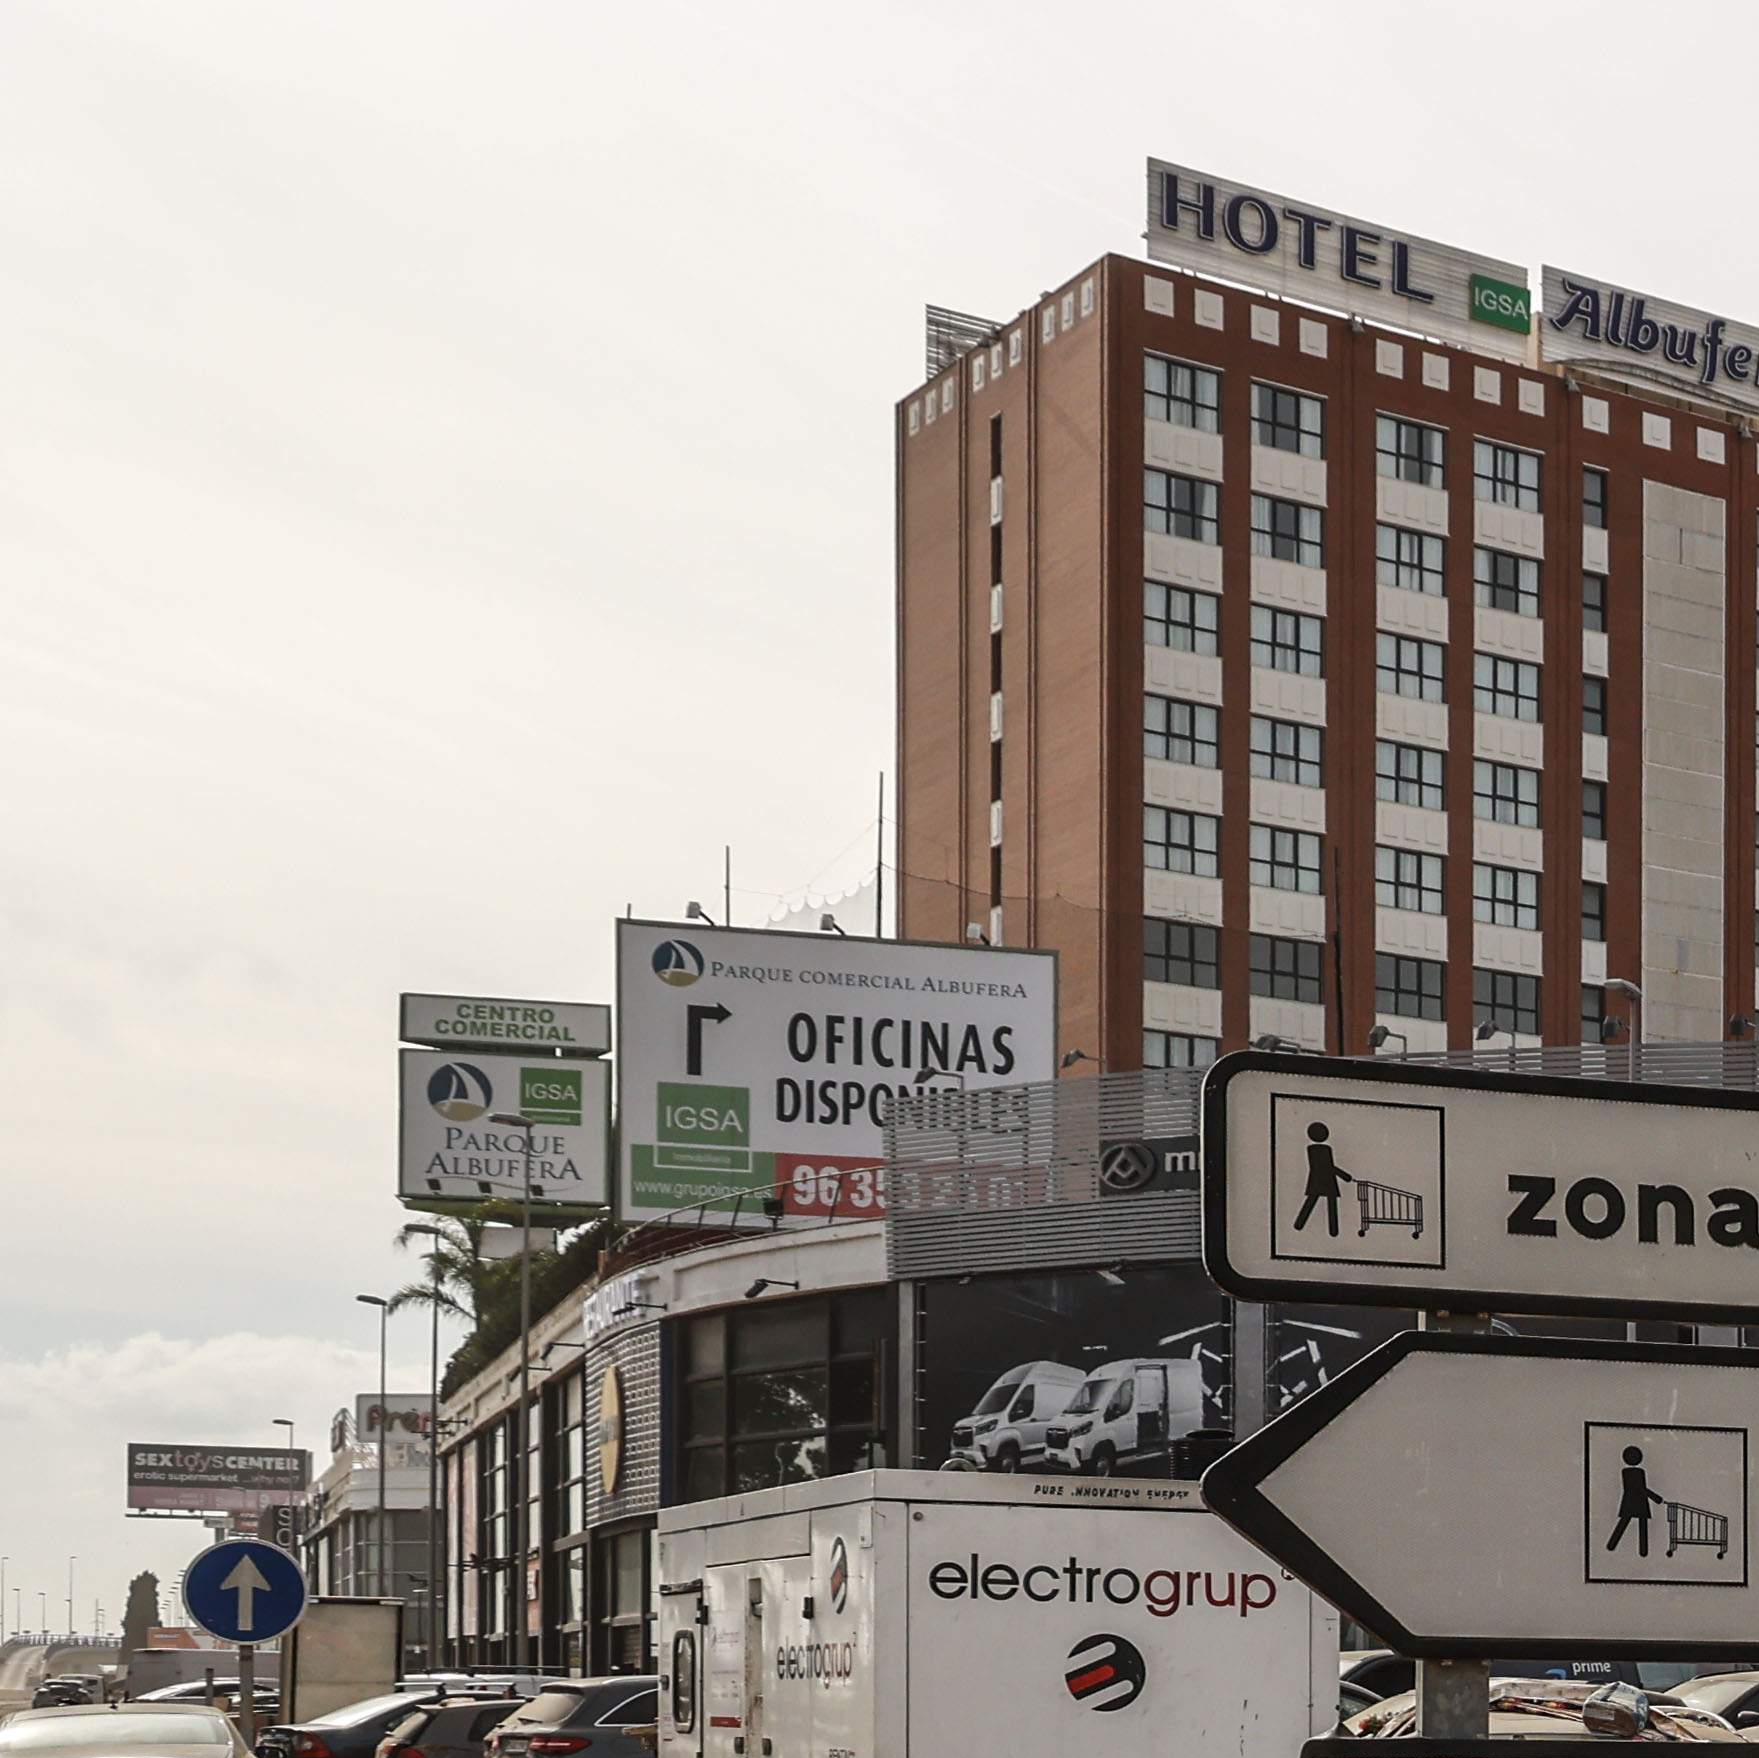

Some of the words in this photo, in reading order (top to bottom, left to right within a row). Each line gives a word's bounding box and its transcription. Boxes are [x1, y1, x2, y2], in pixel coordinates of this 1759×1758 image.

[1160, 171, 1434, 304] HOTEL
[1474, 287, 1529, 321] IGSA
[710, 961, 793, 983] PARQUE
[799, 969, 915, 991] COMERCIAL
[920, 976, 1028, 999] ALBUFERA
[434, 1018, 576, 1042] COMERCIAL
[456, 1004, 555, 1024] CENTRO
[787, 1012, 1015, 1076] OFICINAS
[525, 1083, 578, 1101] IGSA
[665, 1104, 743, 1133] IGSA
[444, 1127, 566, 1158] PARQUE
[425, 1152, 583, 1181] ALBUFERA
[791, 1164, 842, 1207] 96
[928, 1553, 1277, 1617] electrogrup
[776, 1635, 852, 1690] electrogrup
[1571, 1660, 1612, 1677] prime
